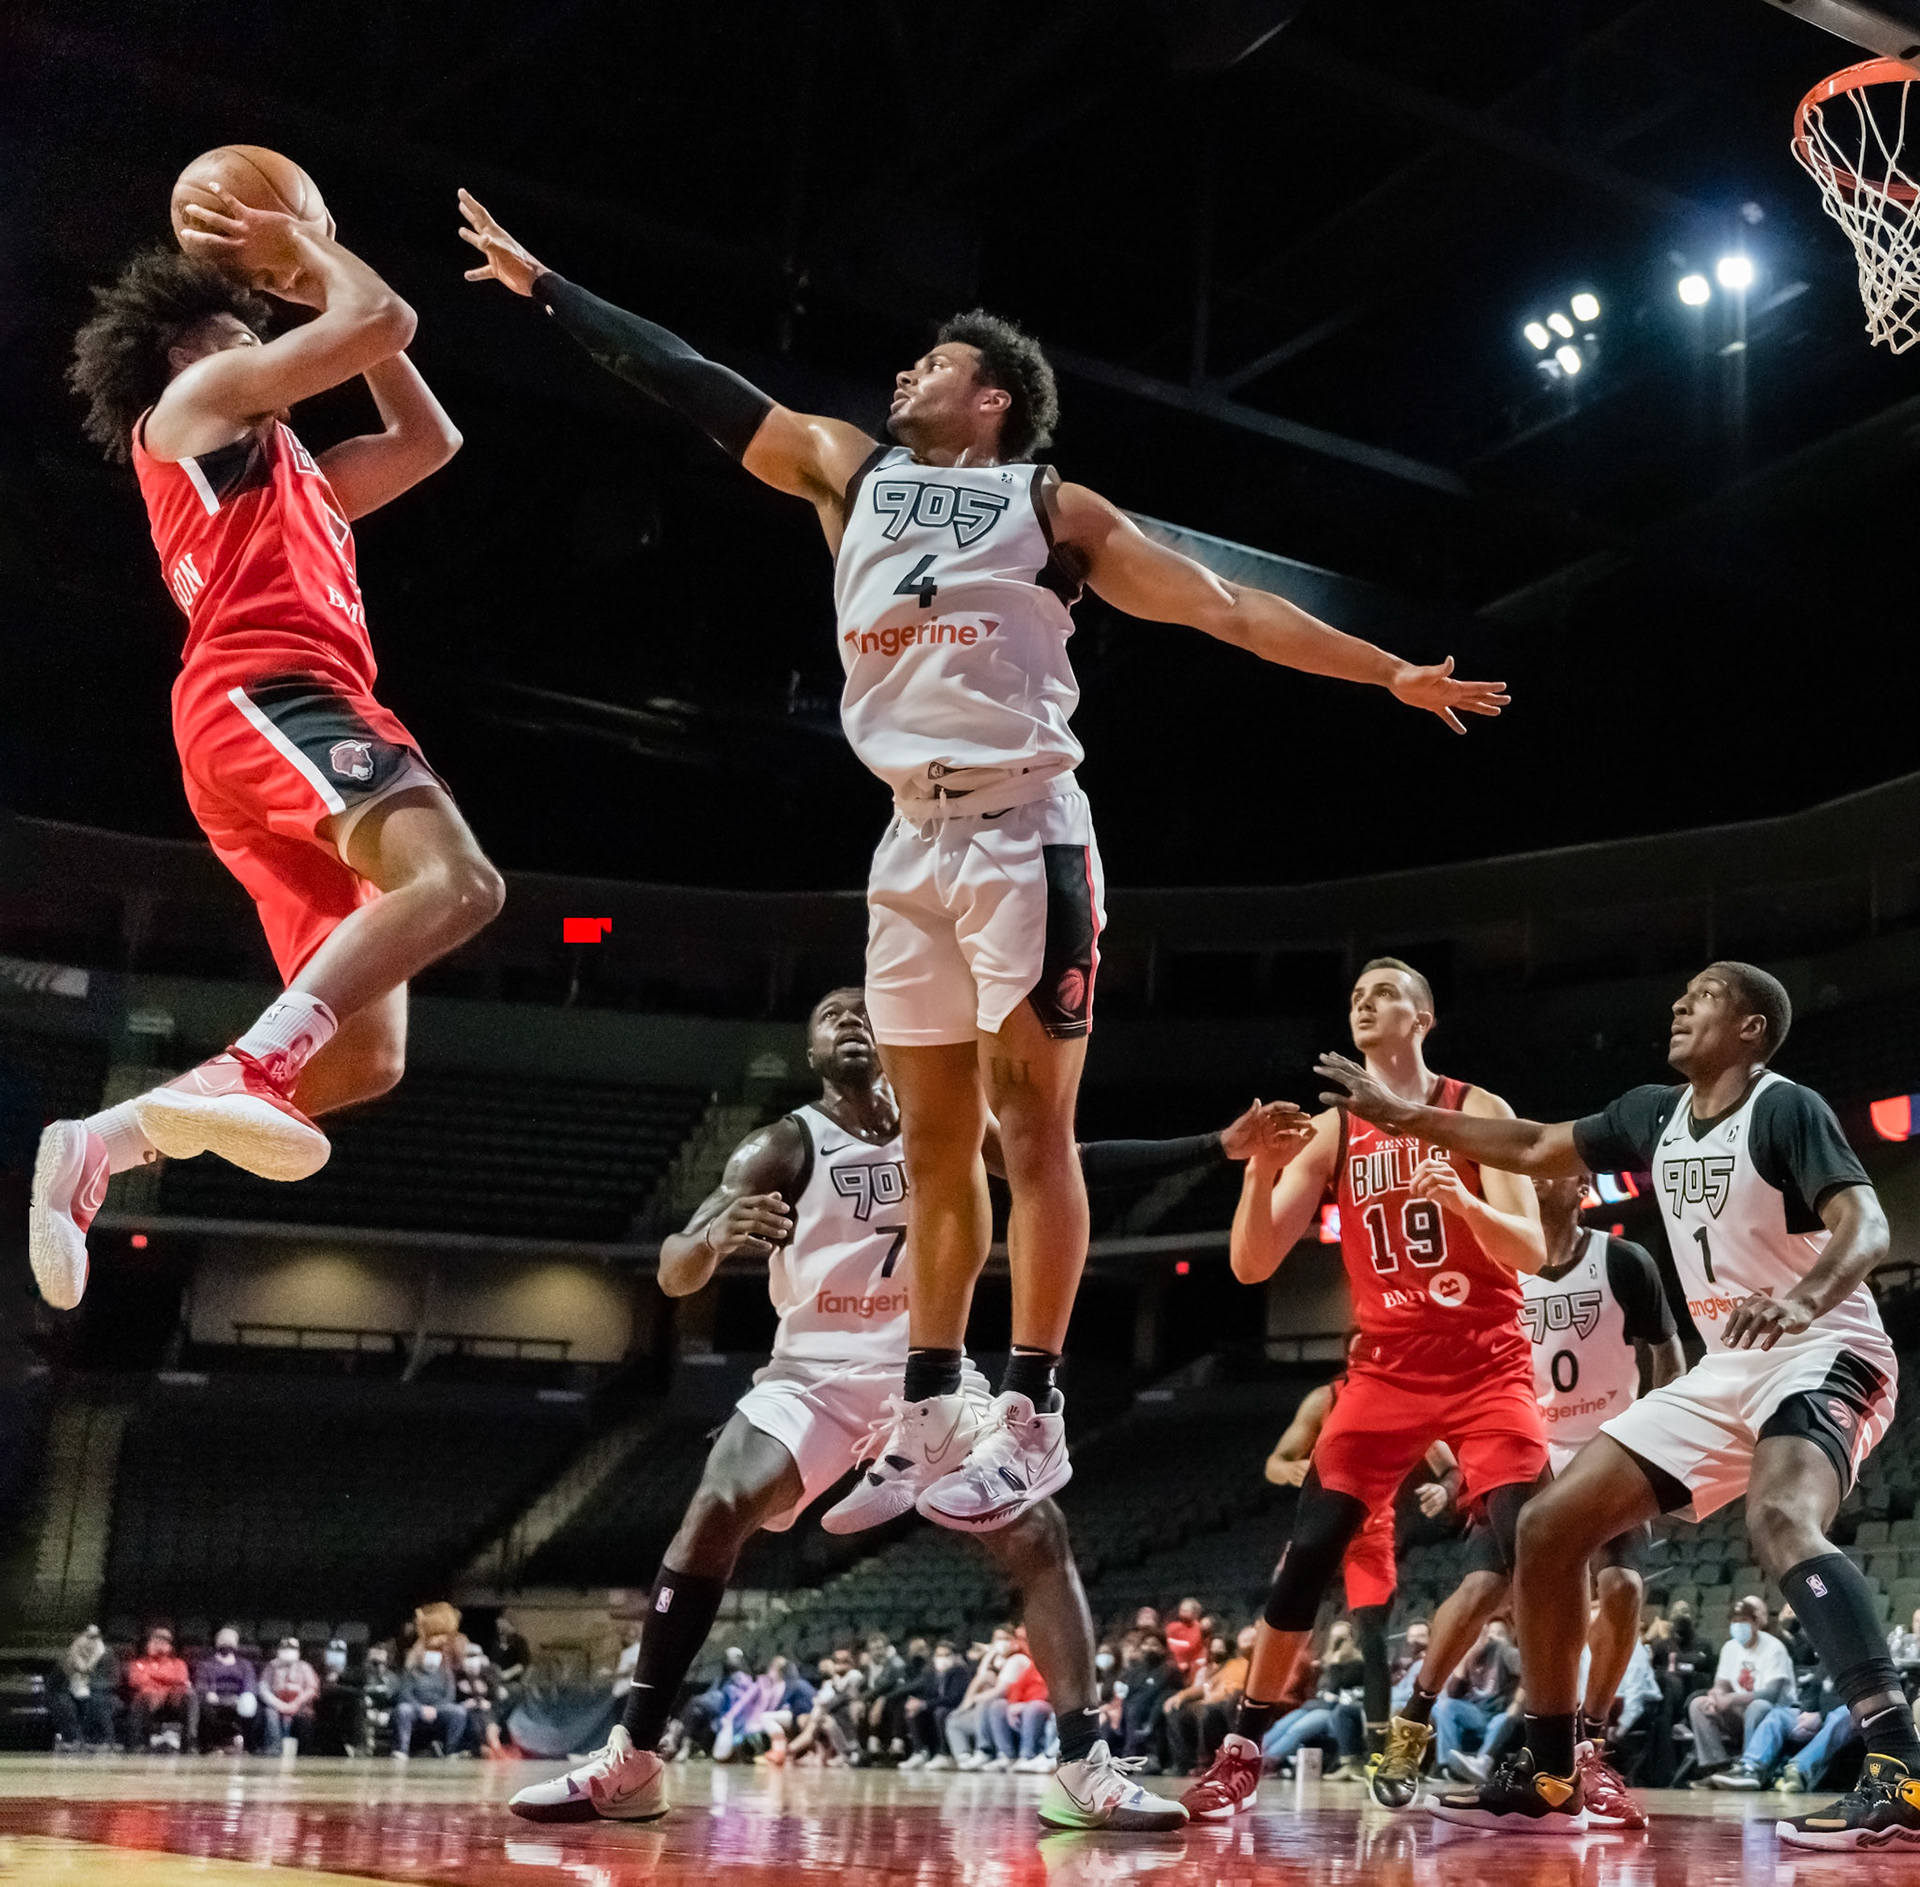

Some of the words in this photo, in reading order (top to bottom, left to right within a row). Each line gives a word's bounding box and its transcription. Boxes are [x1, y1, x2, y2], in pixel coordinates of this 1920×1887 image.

[874, 481, 1009, 548] 905
[894, 554, 938, 608] 4
[844, 616, 978, 656] Tngerine
[830, 1161, 909, 1222] 90
[1663, 1156, 1735, 1219] 905
[875, 1224, 907, 1278] 7
[1362, 1198, 1448, 1274] 19
[1693, 1226, 1716, 1283] 1
[1518, 1291, 1602, 1344] 905
[1551, 1350, 1579, 1393] 0
